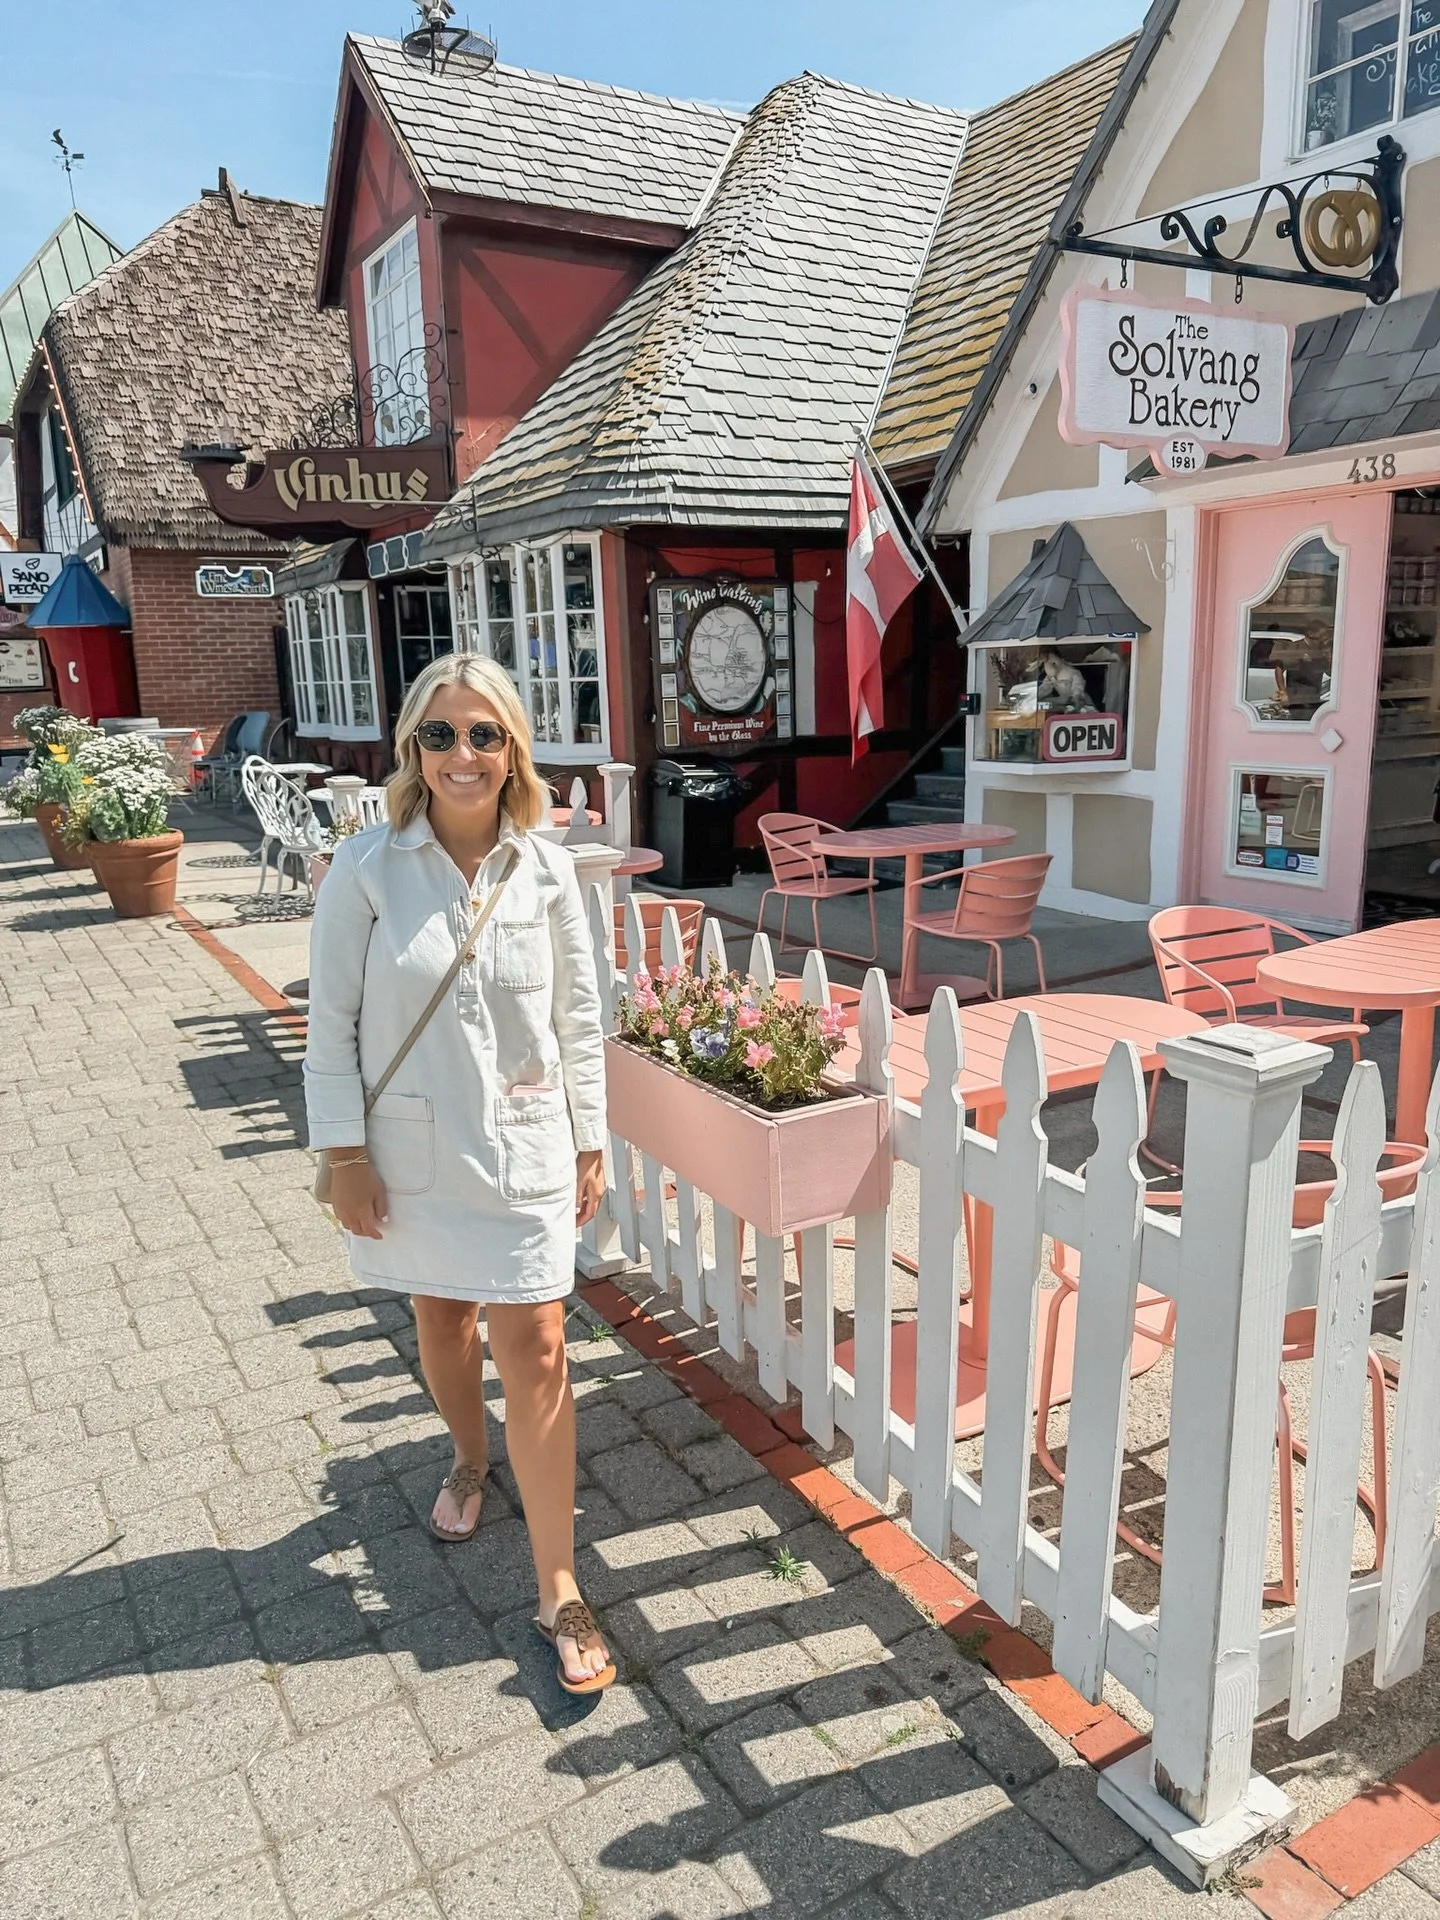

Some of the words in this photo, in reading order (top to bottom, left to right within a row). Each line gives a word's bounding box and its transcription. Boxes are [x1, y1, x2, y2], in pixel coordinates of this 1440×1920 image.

[1175, 314, 1209, 340] The
[1108, 315, 1260, 404] Solvang
[1128, 377, 1241, 441] Bakery
[1172, 441, 1194, 453] EST
[1171, 456, 1196, 469] 1981
[1347, 453, 1396, 484] 438
[273, 456, 429, 512] Vinhus
[12, 568, 50, 583] SANO
[8, 583, 50, 595] PECAD
[201, 579, 232, 593] Wines
[682, 588, 717, 611] Wine
[717, 582, 763, 615] Tasting
[693, 721, 711, 732] Fine
[711, 719, 744, 731] Premium
[745, 718, 764, 729] Wine
[708, 732, 718, 742] by
[718, 731, 730, 741] the
[731, 730, 751, 740] Glass
[1053, 724, 1115, 752] OPEN
